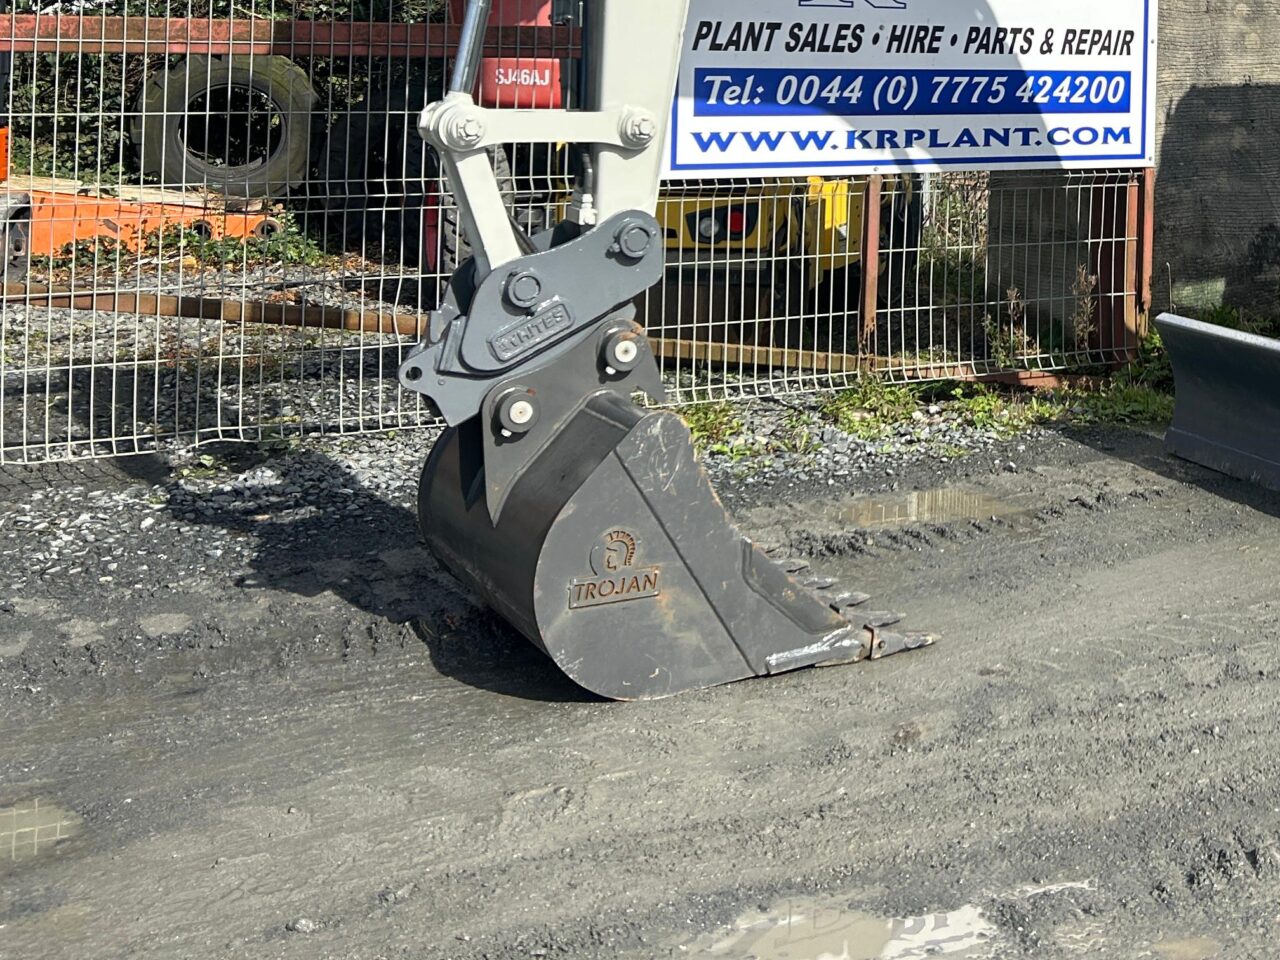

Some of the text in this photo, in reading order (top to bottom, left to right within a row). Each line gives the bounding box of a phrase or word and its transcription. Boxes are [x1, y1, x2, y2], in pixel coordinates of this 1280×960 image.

[692, 21, 1135, 56] PLANT SALES HIRE PARTS & REPAIR
[703, 75, 1126, 111] Tel: 0044 (0) 7775 424200
[690, 126, 1132, 153] WWW.KRPLANT.COM
[574, 573, 659, 601] TROJAN
